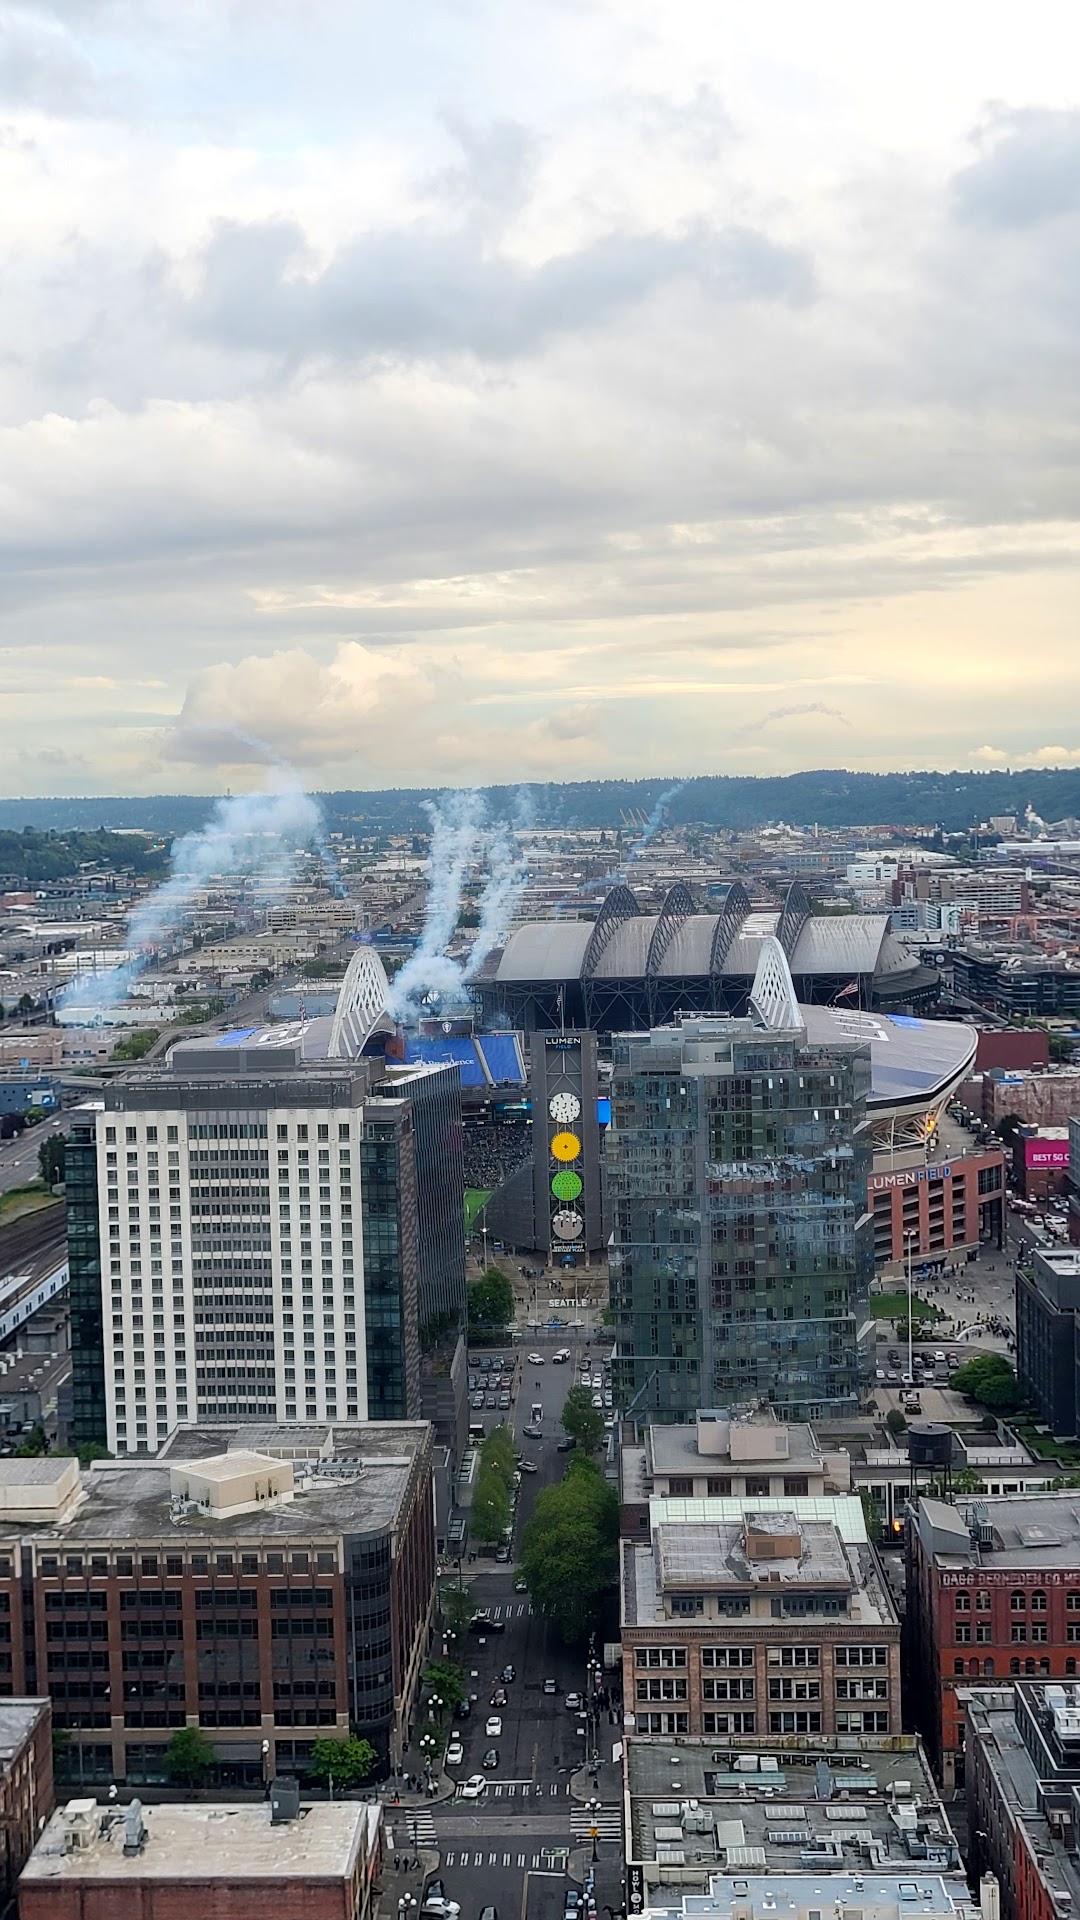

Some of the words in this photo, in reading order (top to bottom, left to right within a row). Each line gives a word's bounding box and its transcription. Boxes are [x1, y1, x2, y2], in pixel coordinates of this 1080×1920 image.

[545, 1037, 581, 1045] LUMEN
[1032, 1153, 1052, 1162] BEST
[1052, 1153, 1064, 1162] 5G
[917, 1166, 951, 1182] FIELD
[549, 1299, 588, 1307] SEATTLE
[631, 1870, 641, 1892] HOWL
